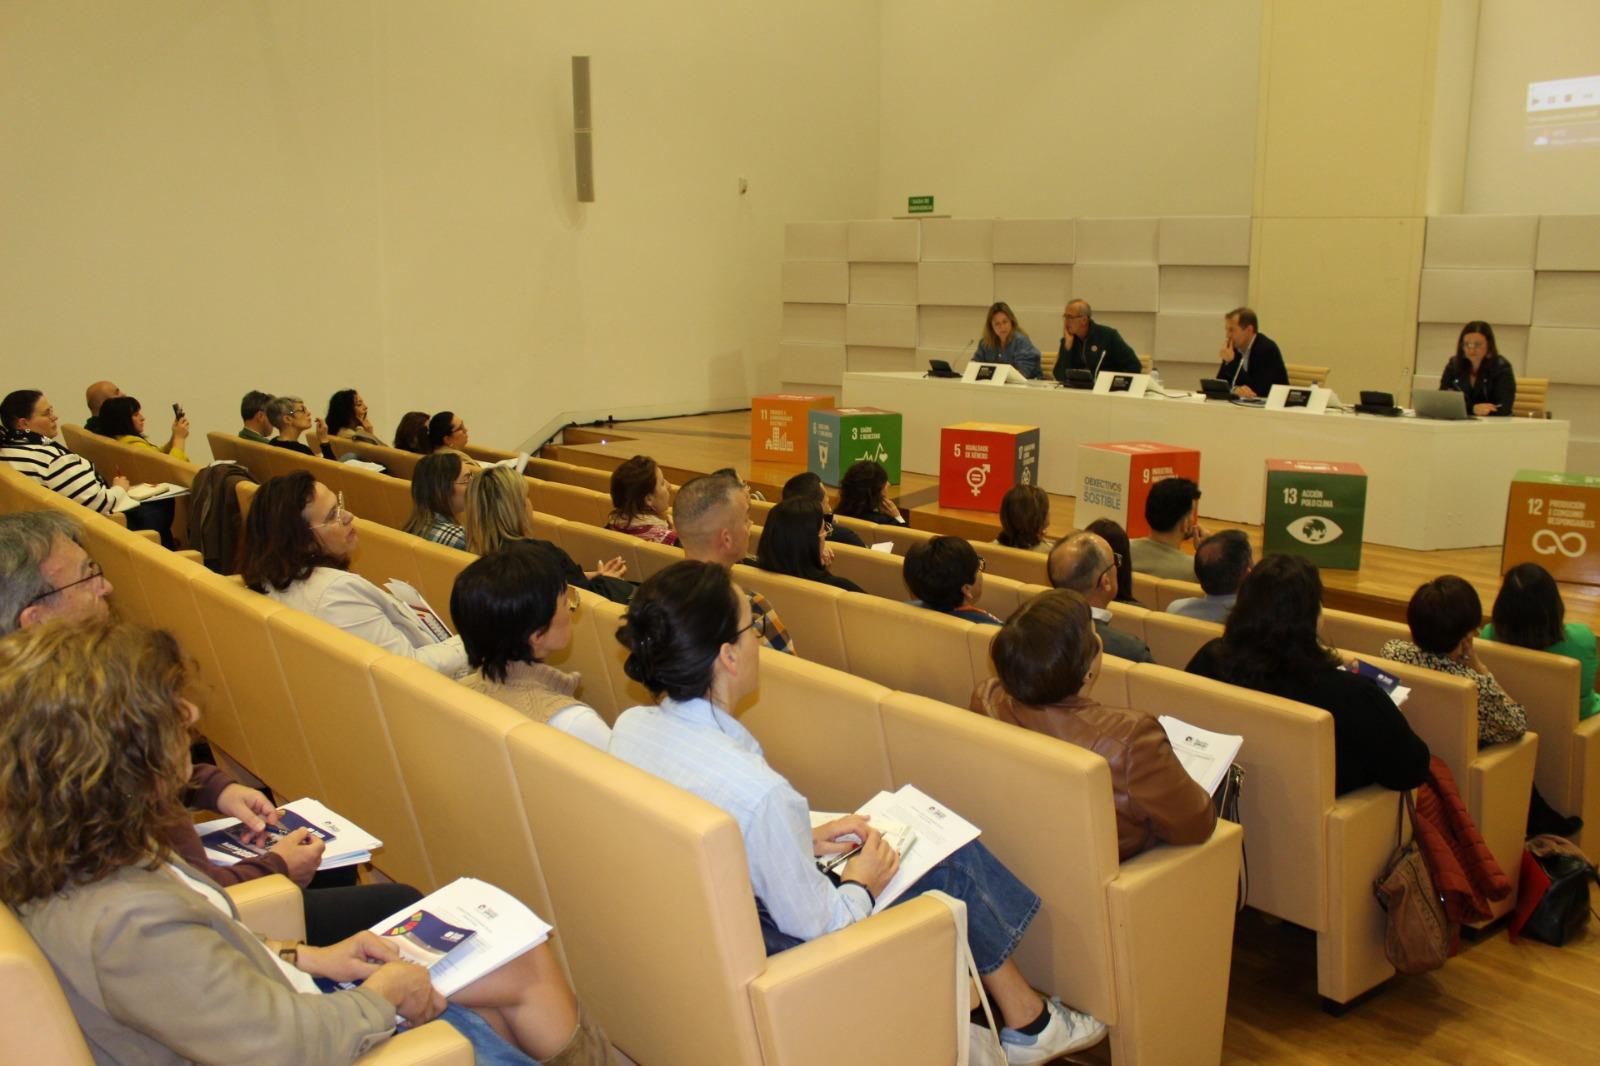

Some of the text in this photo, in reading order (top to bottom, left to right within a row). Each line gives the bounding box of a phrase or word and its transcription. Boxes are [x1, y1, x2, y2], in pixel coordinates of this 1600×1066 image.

[852, 427, 857, 440] 3
[954, 443, 961, 457] 5
[1143, 468, 1150, 483] 9
[1083, 491, 1121, 510] SOSTIBLE
[1283, 488, 1298, 504] 13
[1528, 498, 1543, 515] 12
